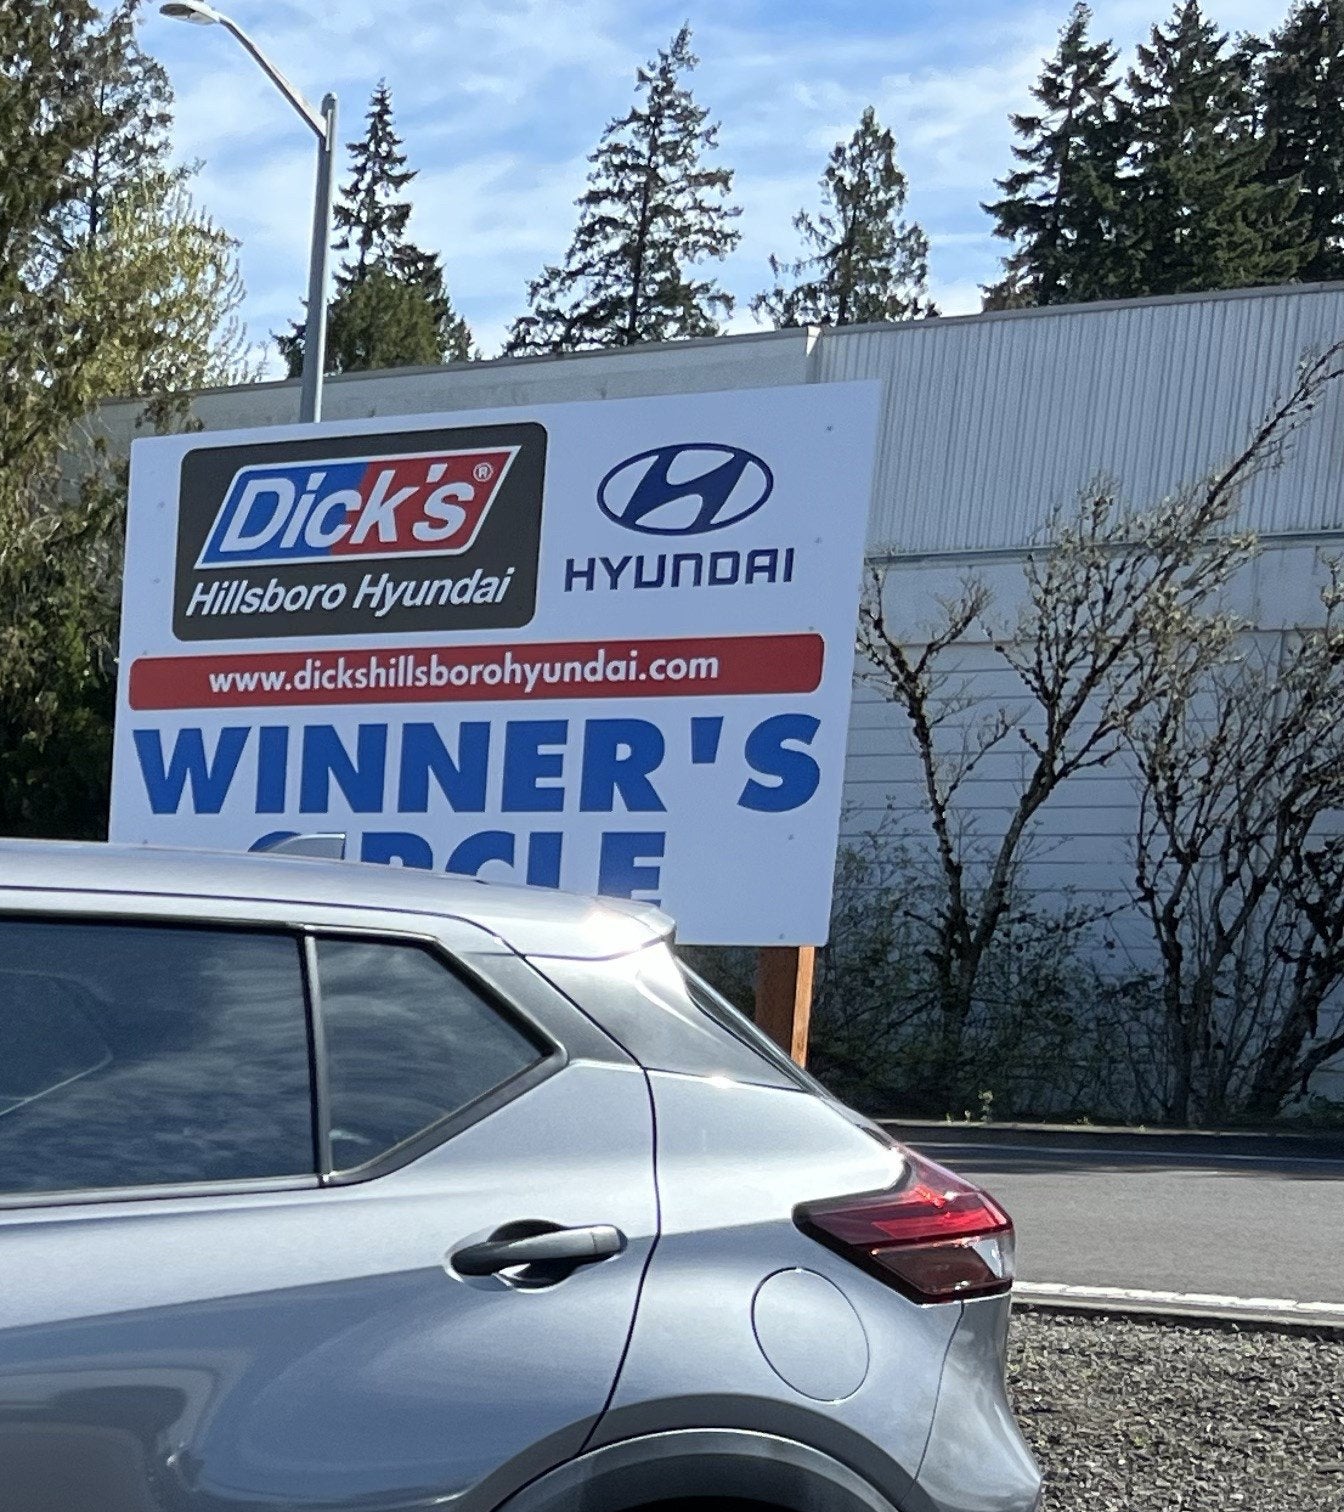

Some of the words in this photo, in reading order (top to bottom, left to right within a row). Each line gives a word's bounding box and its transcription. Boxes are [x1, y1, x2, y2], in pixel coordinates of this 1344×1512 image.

[185, 578, 347, 618] Hillsboro
[352, 567, 515, 618] Hyundai
[564, 547, 795, 593] HYUNDAI
[208, 650, 720, 694] www.dickshillsborohyundai.com
[132, 713, 822, 815] WINNER'S
